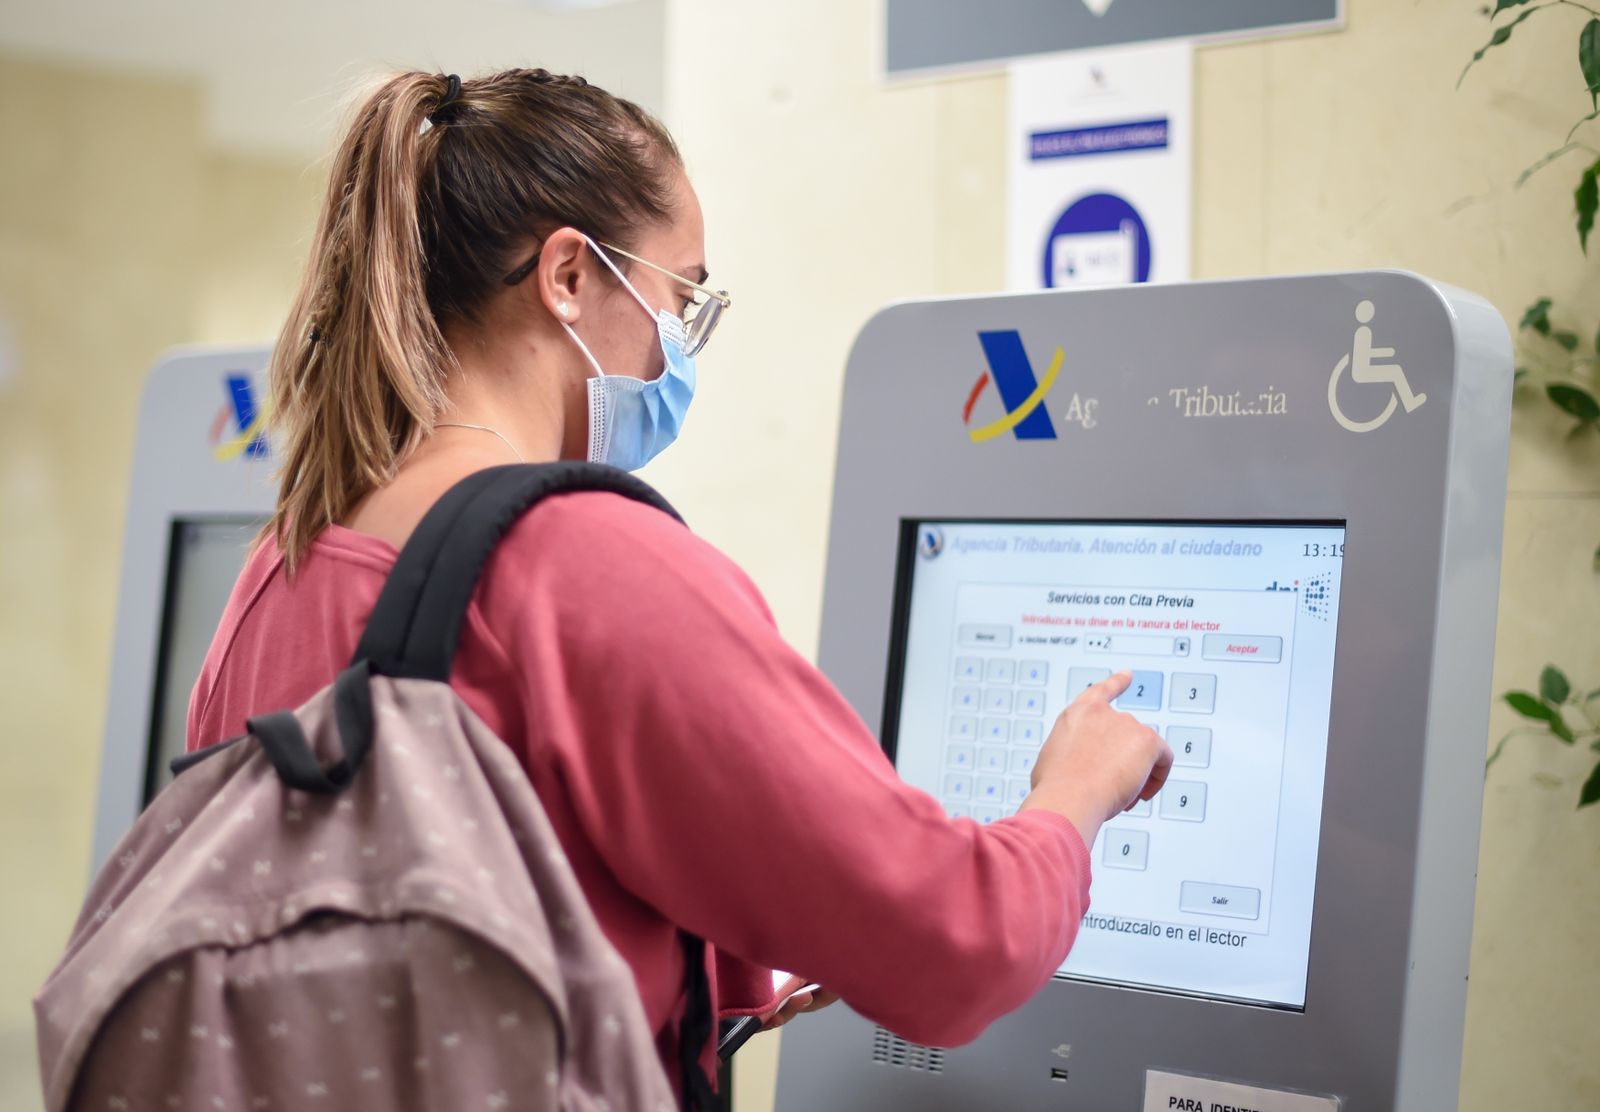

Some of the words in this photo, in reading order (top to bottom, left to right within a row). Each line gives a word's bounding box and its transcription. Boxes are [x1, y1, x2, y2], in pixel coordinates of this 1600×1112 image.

[1088, 538, 1157, 556] Atención
[1161, 539, 1175, 556] al
[1179, 539, 1263, 557] ciudadano
[1047, 590, 1100, 605] Servicios
[1103, 595, 1125, 606] con
[1129, 594, 1152, 607] Cita
[1156, 595, 1195, 608] Previa
[1126, 616, 1135, 629] la
[1137, 620, 1170, 630] ranura
[1173, 618, 1189, 630] del
[1191, 619, 1221, 632] lector
[1226, 643, 1259, 655] Aceptar
[1136, 685, 1144, 697] 2
[1189, 688, 1197, 700] 3
[1184, 742, 1192, 754] 6
[1180, 795, 1188, 807] 9
[1122, 844, 1130, 856] 0
[1211, 896, 1229, 905] Salir
[1166, 926, 1183, 940] en
[1188, 927, 1201, 942] el
[1205, 928, 1247, 948] lector
[1168, 1096, 1203, 1112] PARA
